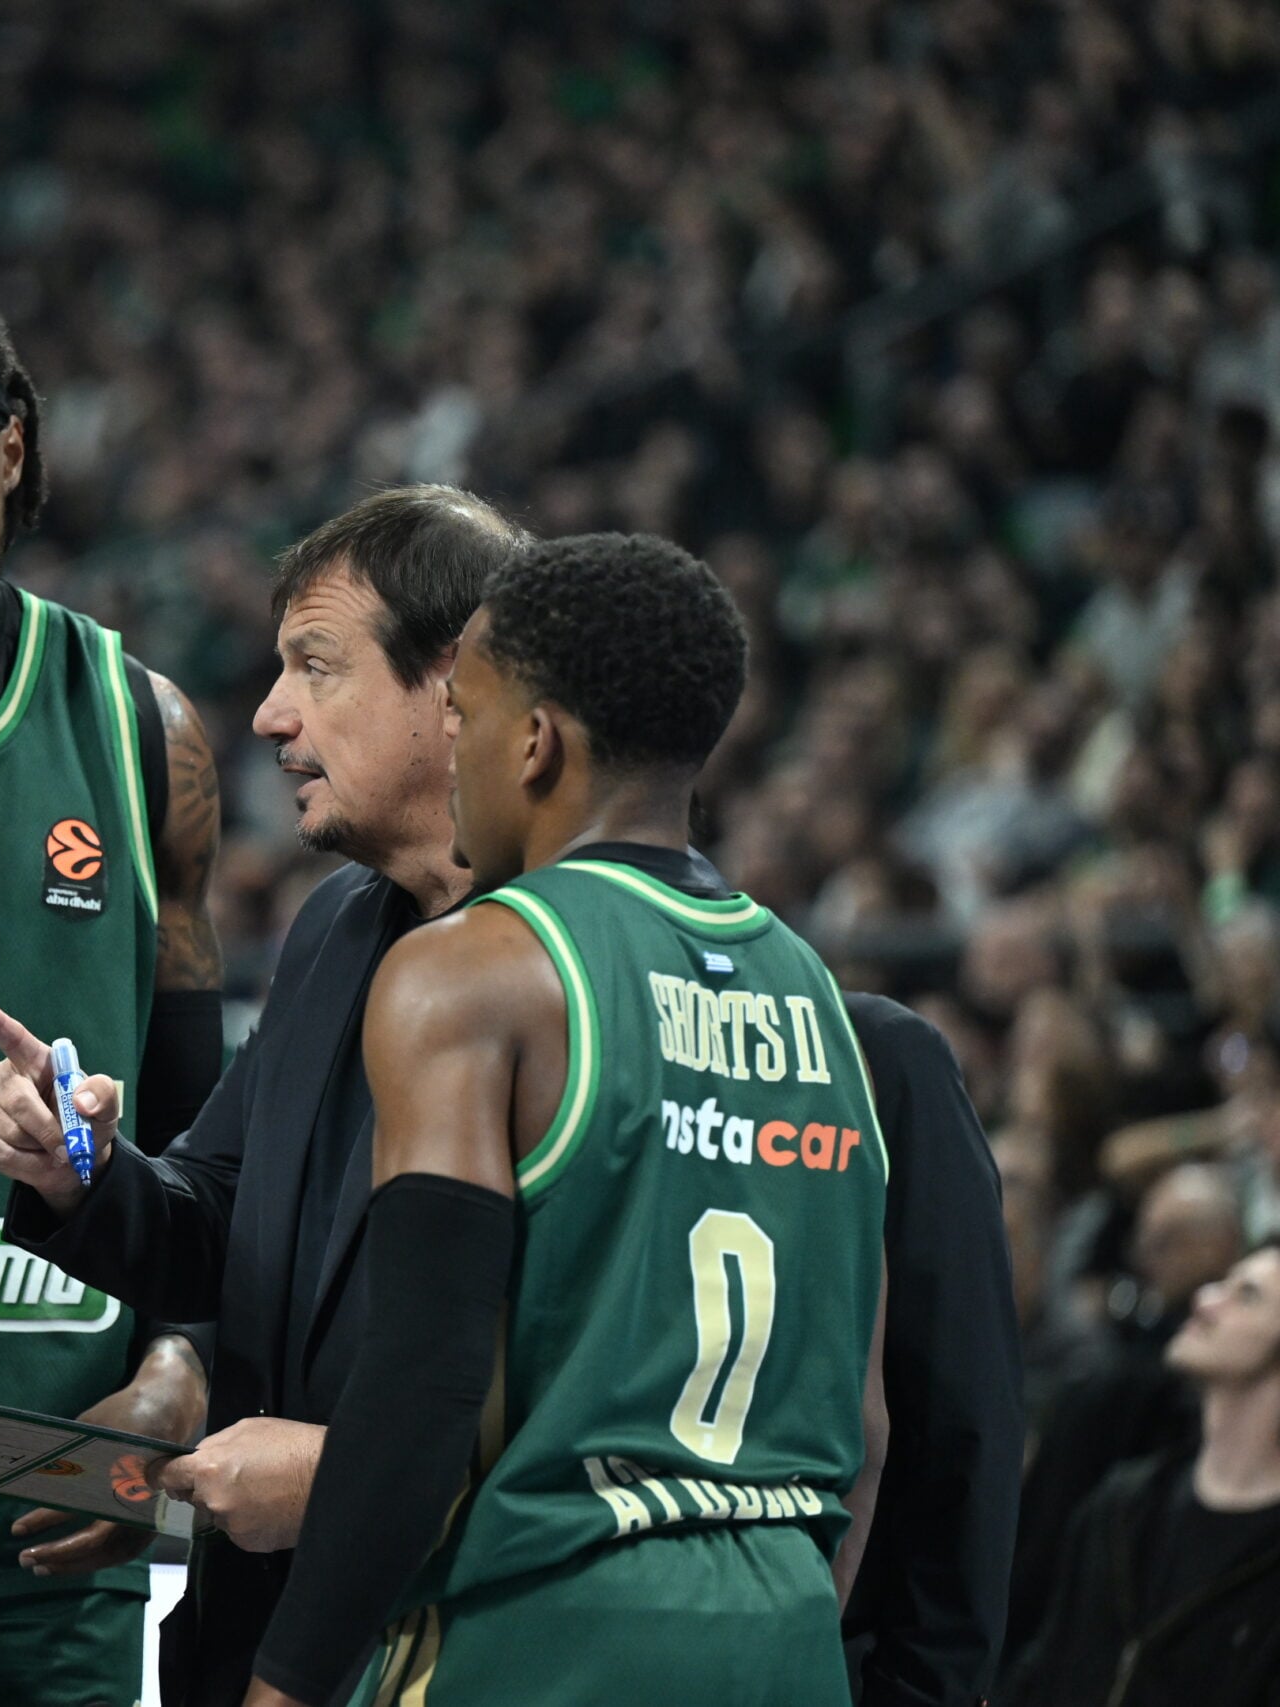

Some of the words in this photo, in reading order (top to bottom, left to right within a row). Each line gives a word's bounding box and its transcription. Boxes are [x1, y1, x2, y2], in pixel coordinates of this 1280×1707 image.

[648, 971, 787, 1081] SHORTS
[784, 995, 832, 1084] II
[62, 1094, 73, 1129] BOARD
[661, 1097, 860, 1172] nstacar
[670, 1208, 776, 1465] 0
